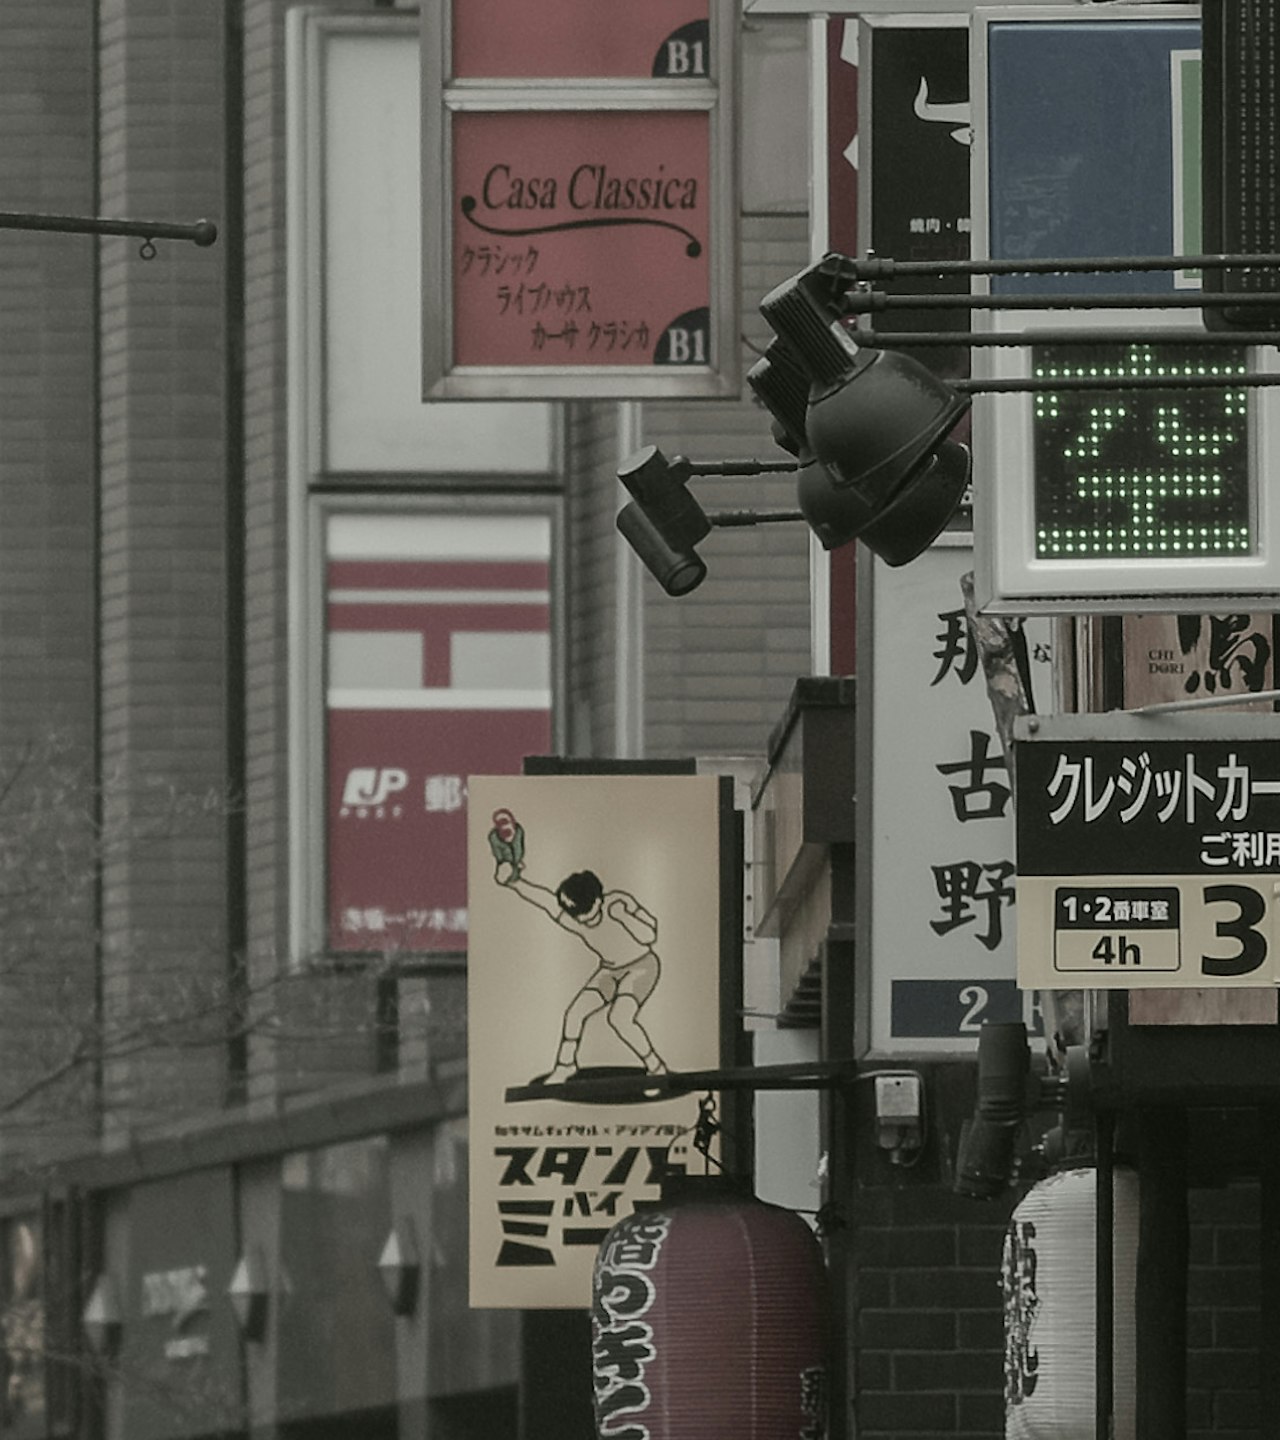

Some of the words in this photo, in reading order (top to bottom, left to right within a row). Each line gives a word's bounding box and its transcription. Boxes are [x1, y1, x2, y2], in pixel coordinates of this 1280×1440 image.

[668, 41, 705, 74] B1
[482, 164, 557, 211] Casa
[568, 164, 697, 211] Classica
[461, 246, 540, 277] クラシック
[496, 285, 593, 316] ライブハウス
[668, 329, 705, 362] B1
[343, 767, 408, 805] JP
[1091, 936, 1142, 965] 4h
[563, 1191, 623, 1217] バイ
